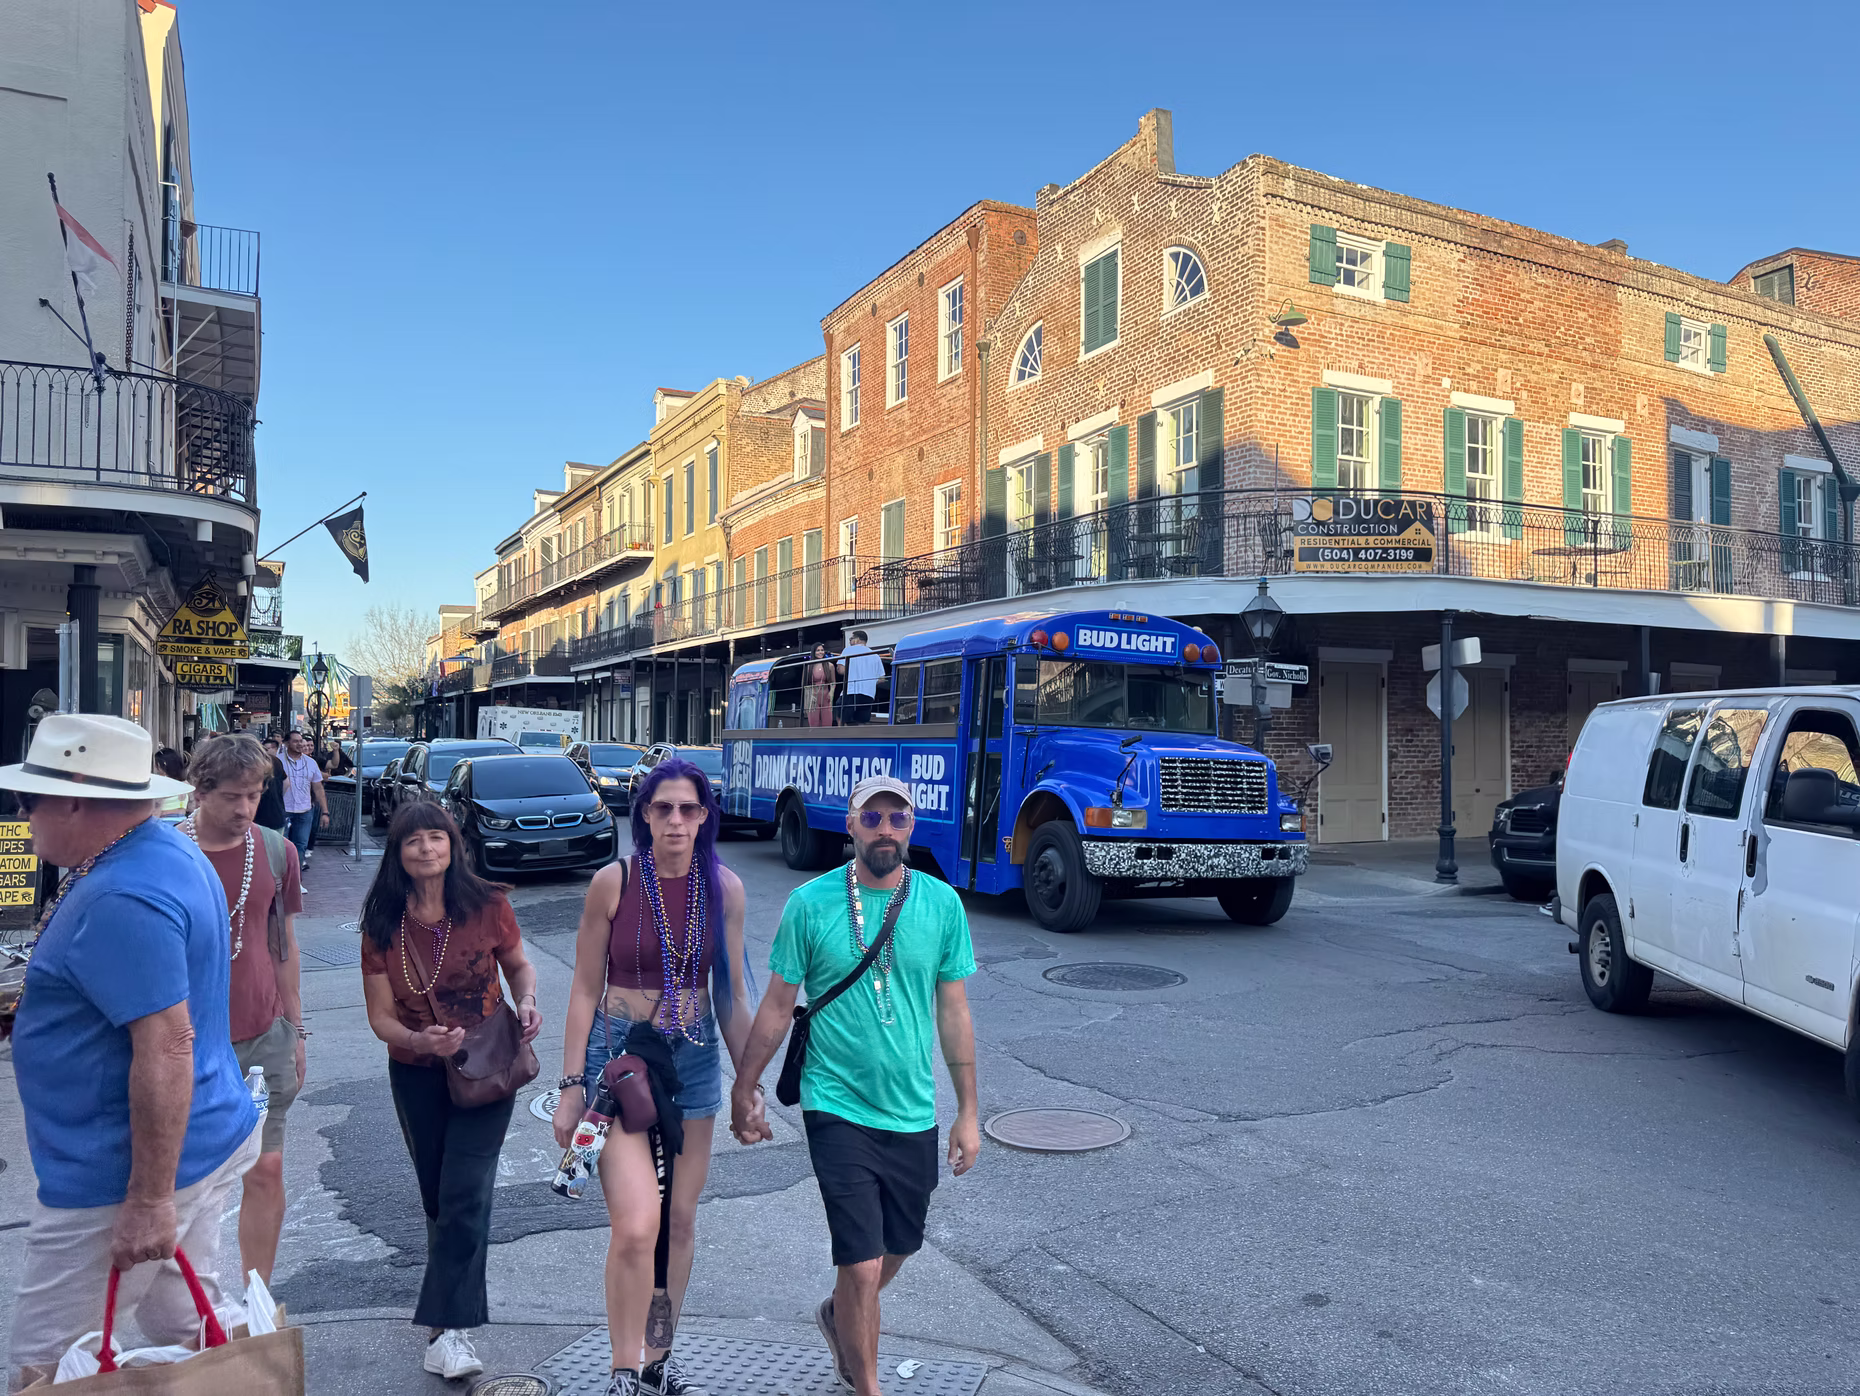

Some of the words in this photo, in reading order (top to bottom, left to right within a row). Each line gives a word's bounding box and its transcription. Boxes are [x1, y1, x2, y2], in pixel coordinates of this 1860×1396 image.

[1339, 498, 1427, 520] DUCAR
[1297, 523, 1398, 535] CONSTRUCTION
[1300, 538, 1362, 546] RESIDENTIAL
[1364, 538, 1371, 546] &
[1373, 538, 1432, 547] COMMERCIAL
[1318, 548, 1354, 562] (504)
[1358, 549, 1415, 560] 407-3199
[1305, 562, 1423, 570] WWW.DUCARCOMPANIES.COM
[172, 619, 193, 635] RA
[196, 620, 238, 638] SHOP
[1078, 629, 1119, 648] BUD
[170, 645, 202, 654] SMOKE
[204, 647, 211, 655] &
[213, 647, 236, 656] VAPE
[180, 663, 223, 675] CIGARS
[1267, 668, 1281, 679] Gov.
[1282, 670, 1307, 681] Nicholls
[733, 740, 751, 764] BUD
[911, 754, 946, 781] BUD
[755, 754, 789, 790] DRINK
[826, 756, 849, 798] BIG
[903, 782, 950, 812] IGHT
